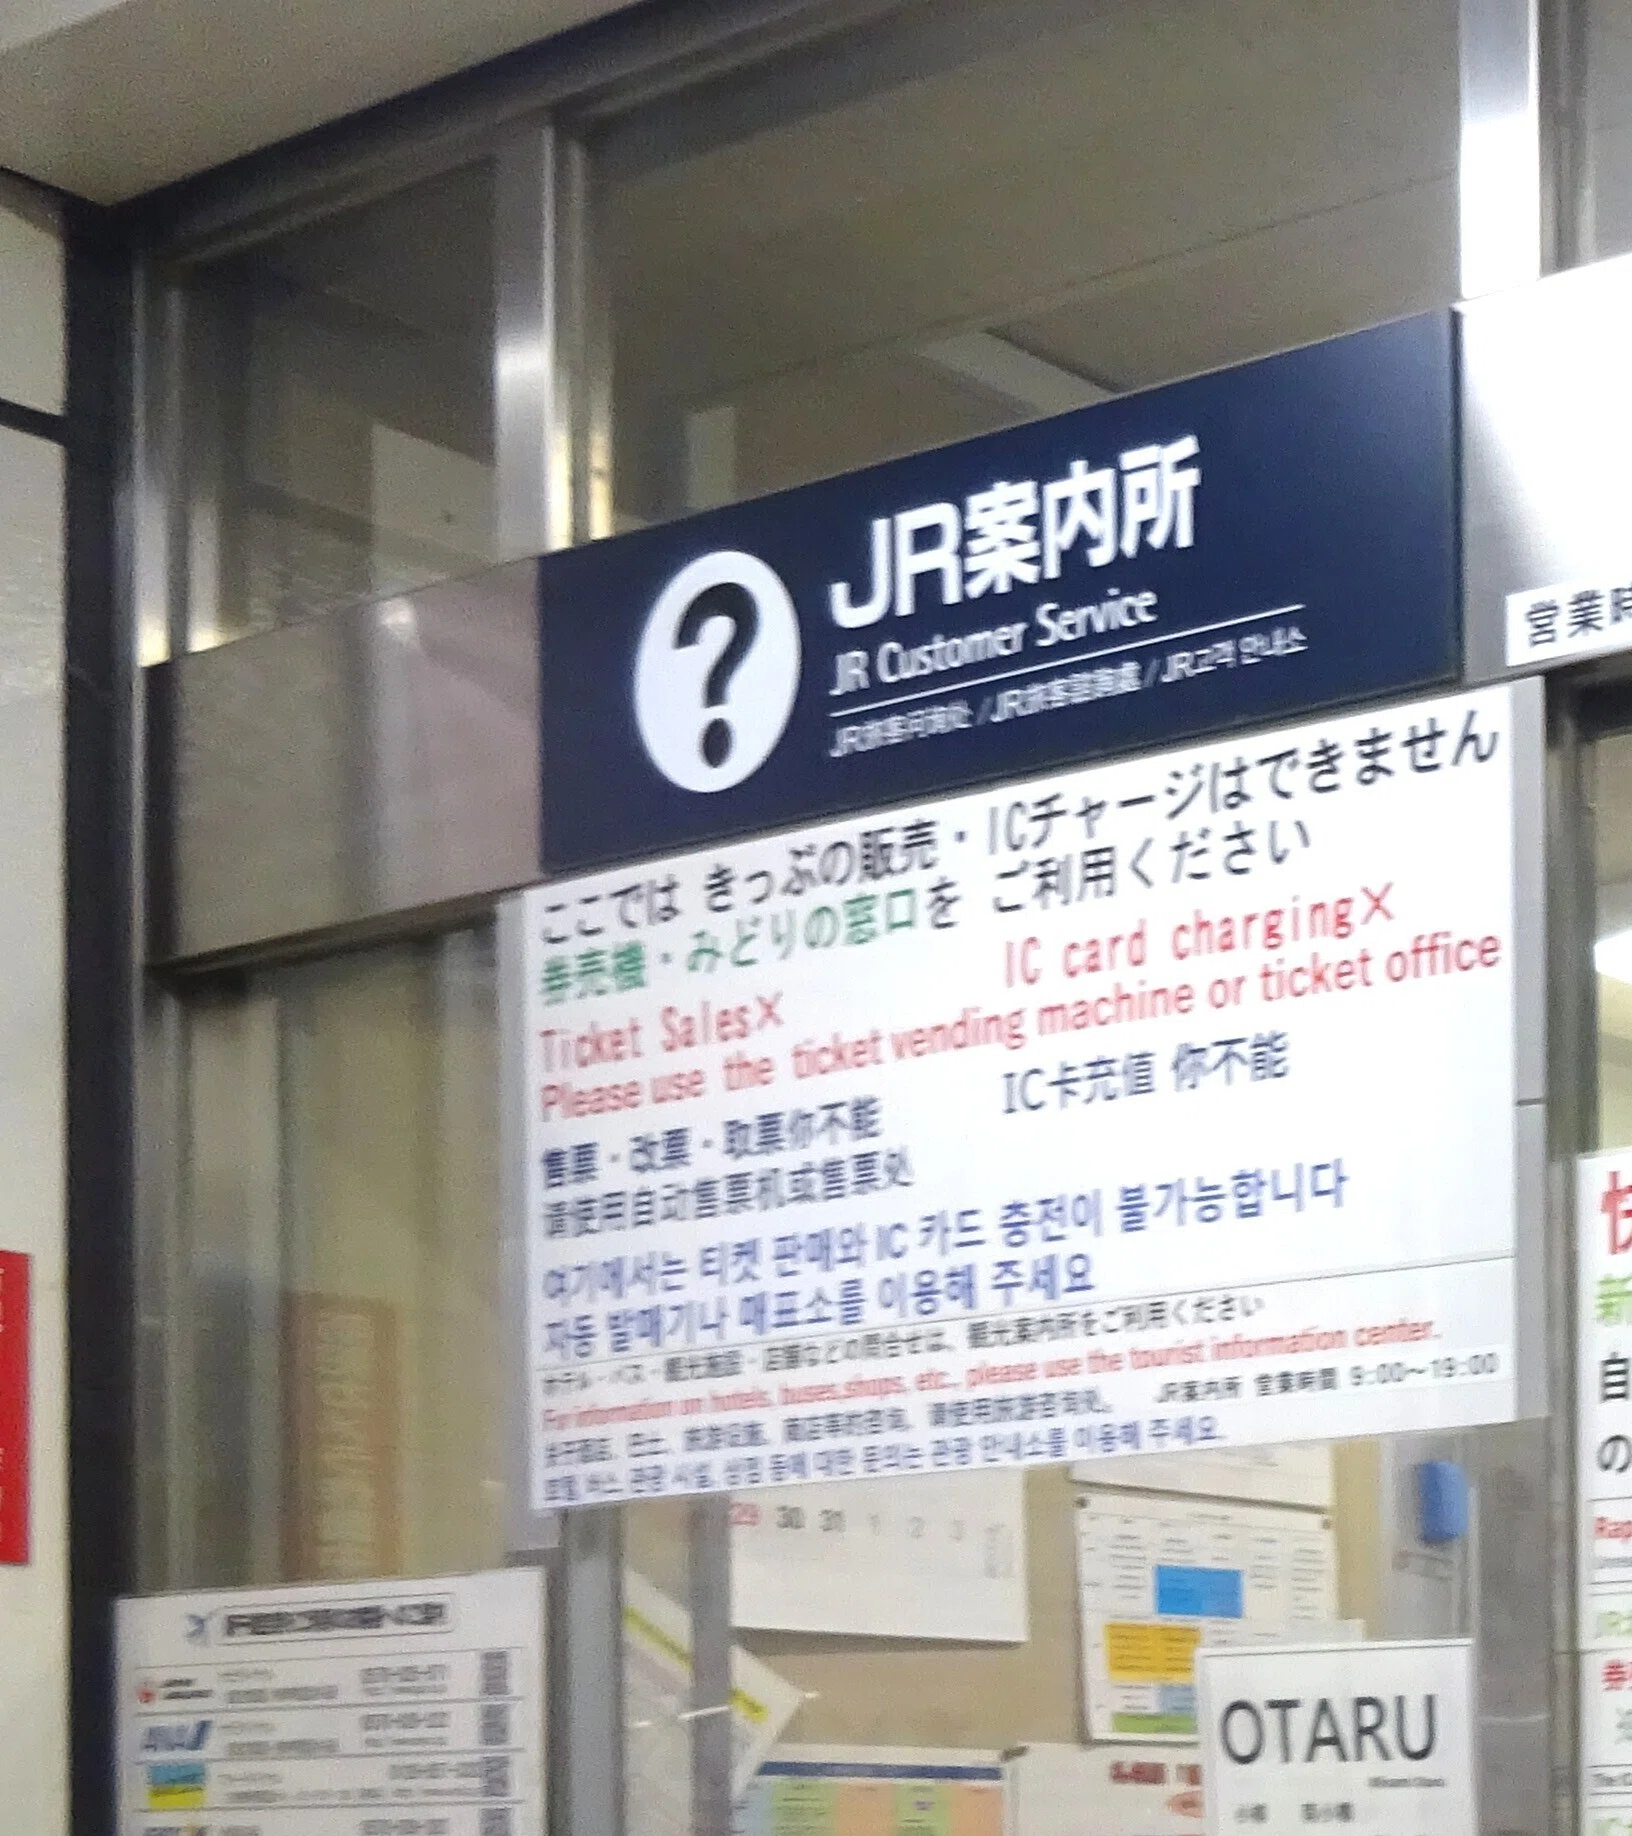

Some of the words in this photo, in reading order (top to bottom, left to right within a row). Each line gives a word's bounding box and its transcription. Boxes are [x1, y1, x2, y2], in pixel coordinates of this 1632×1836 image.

[828, 432, 1201, 629] JR案内所
[830, 648, 868, 696] JR
[876, 622, 1028, 684] Customer
[1035, 588, 1158, 648] Service
[542, 873, 681, 945] ここでは
[993, 820, 1312, 915] ご利用ください
[540, 1018, 642, 1073] Ticket
[1007, 936, 1042, 987] IC
[1062, 920, 1147, 978] card
[541, 1080, 642, 1122] Please
[652, 1067, 706, 1104] use
[723, 1051, 775, 1092] the
[791, 1029, 883, 1080] ticket
[891, 1004, 1025, 1062] vending
[1037, 978, 1194, 1037] machine
[1207, 972, 1246, 1010] or
[1260, 947, 1373, 1003] ticket
[1385, 931, 1502, 984] office
[877, 1222, 909, 1260] IC
[918, 1208, 987, 1257] 카드
[1118, 1158, 1350, 1233] 불가능합니다
[878, 1262, 976, 1318] 이용해
[991, 1251, 1096, 1308] 주세요
[966, 1361, 1038, 1388] please
[1044, 1357, 1081, 1379] use
[1087, 1349, 1123, 1374] the
[1129, 1339, 1204, 1369] tourist
[1211, 1325, 1346, 1359] information
[1158, 1376, 1242, 1404] JR案内所
[1254, 1366, 1338, 1397] 営業時間
[1220, 1694, 1440, 1765] OTARU
